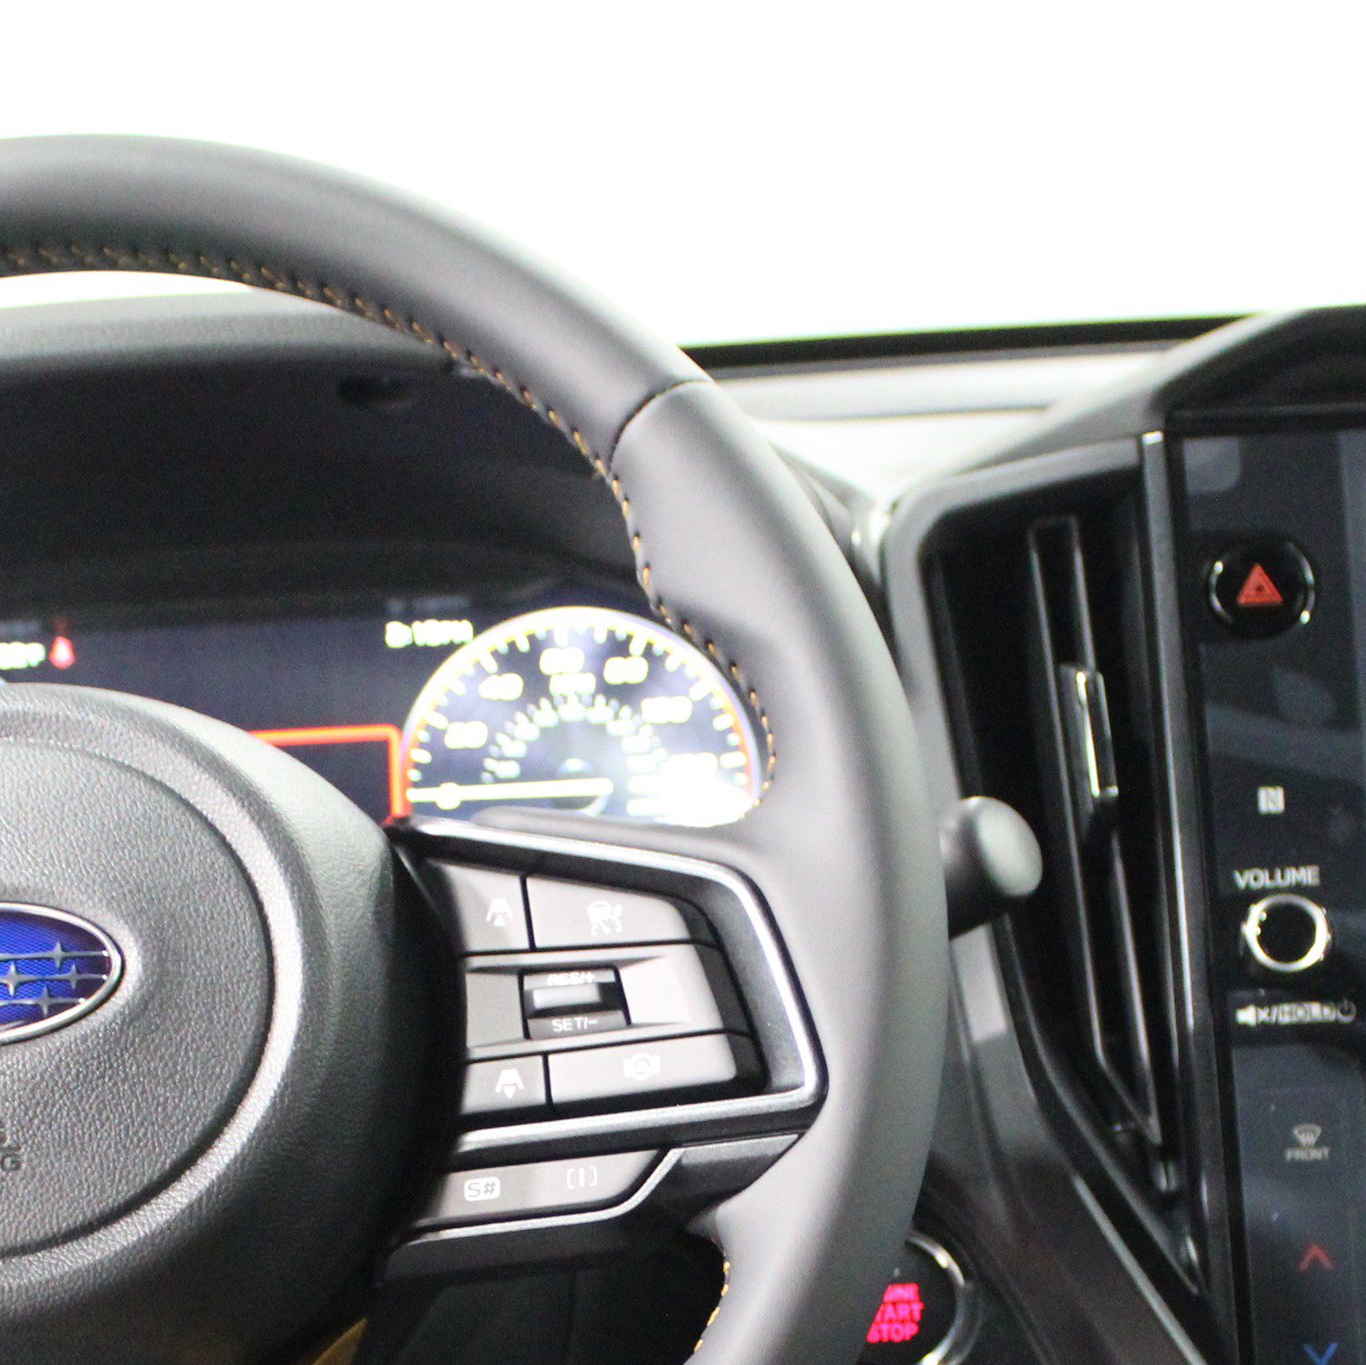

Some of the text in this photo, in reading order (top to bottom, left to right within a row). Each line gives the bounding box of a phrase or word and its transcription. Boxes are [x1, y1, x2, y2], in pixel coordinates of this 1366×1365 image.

[1234, 865, 1321, 890] VOLUME
[1285, 1147, 1330, 1162] FRONT
[875, 1302, 924, 1322] ART
